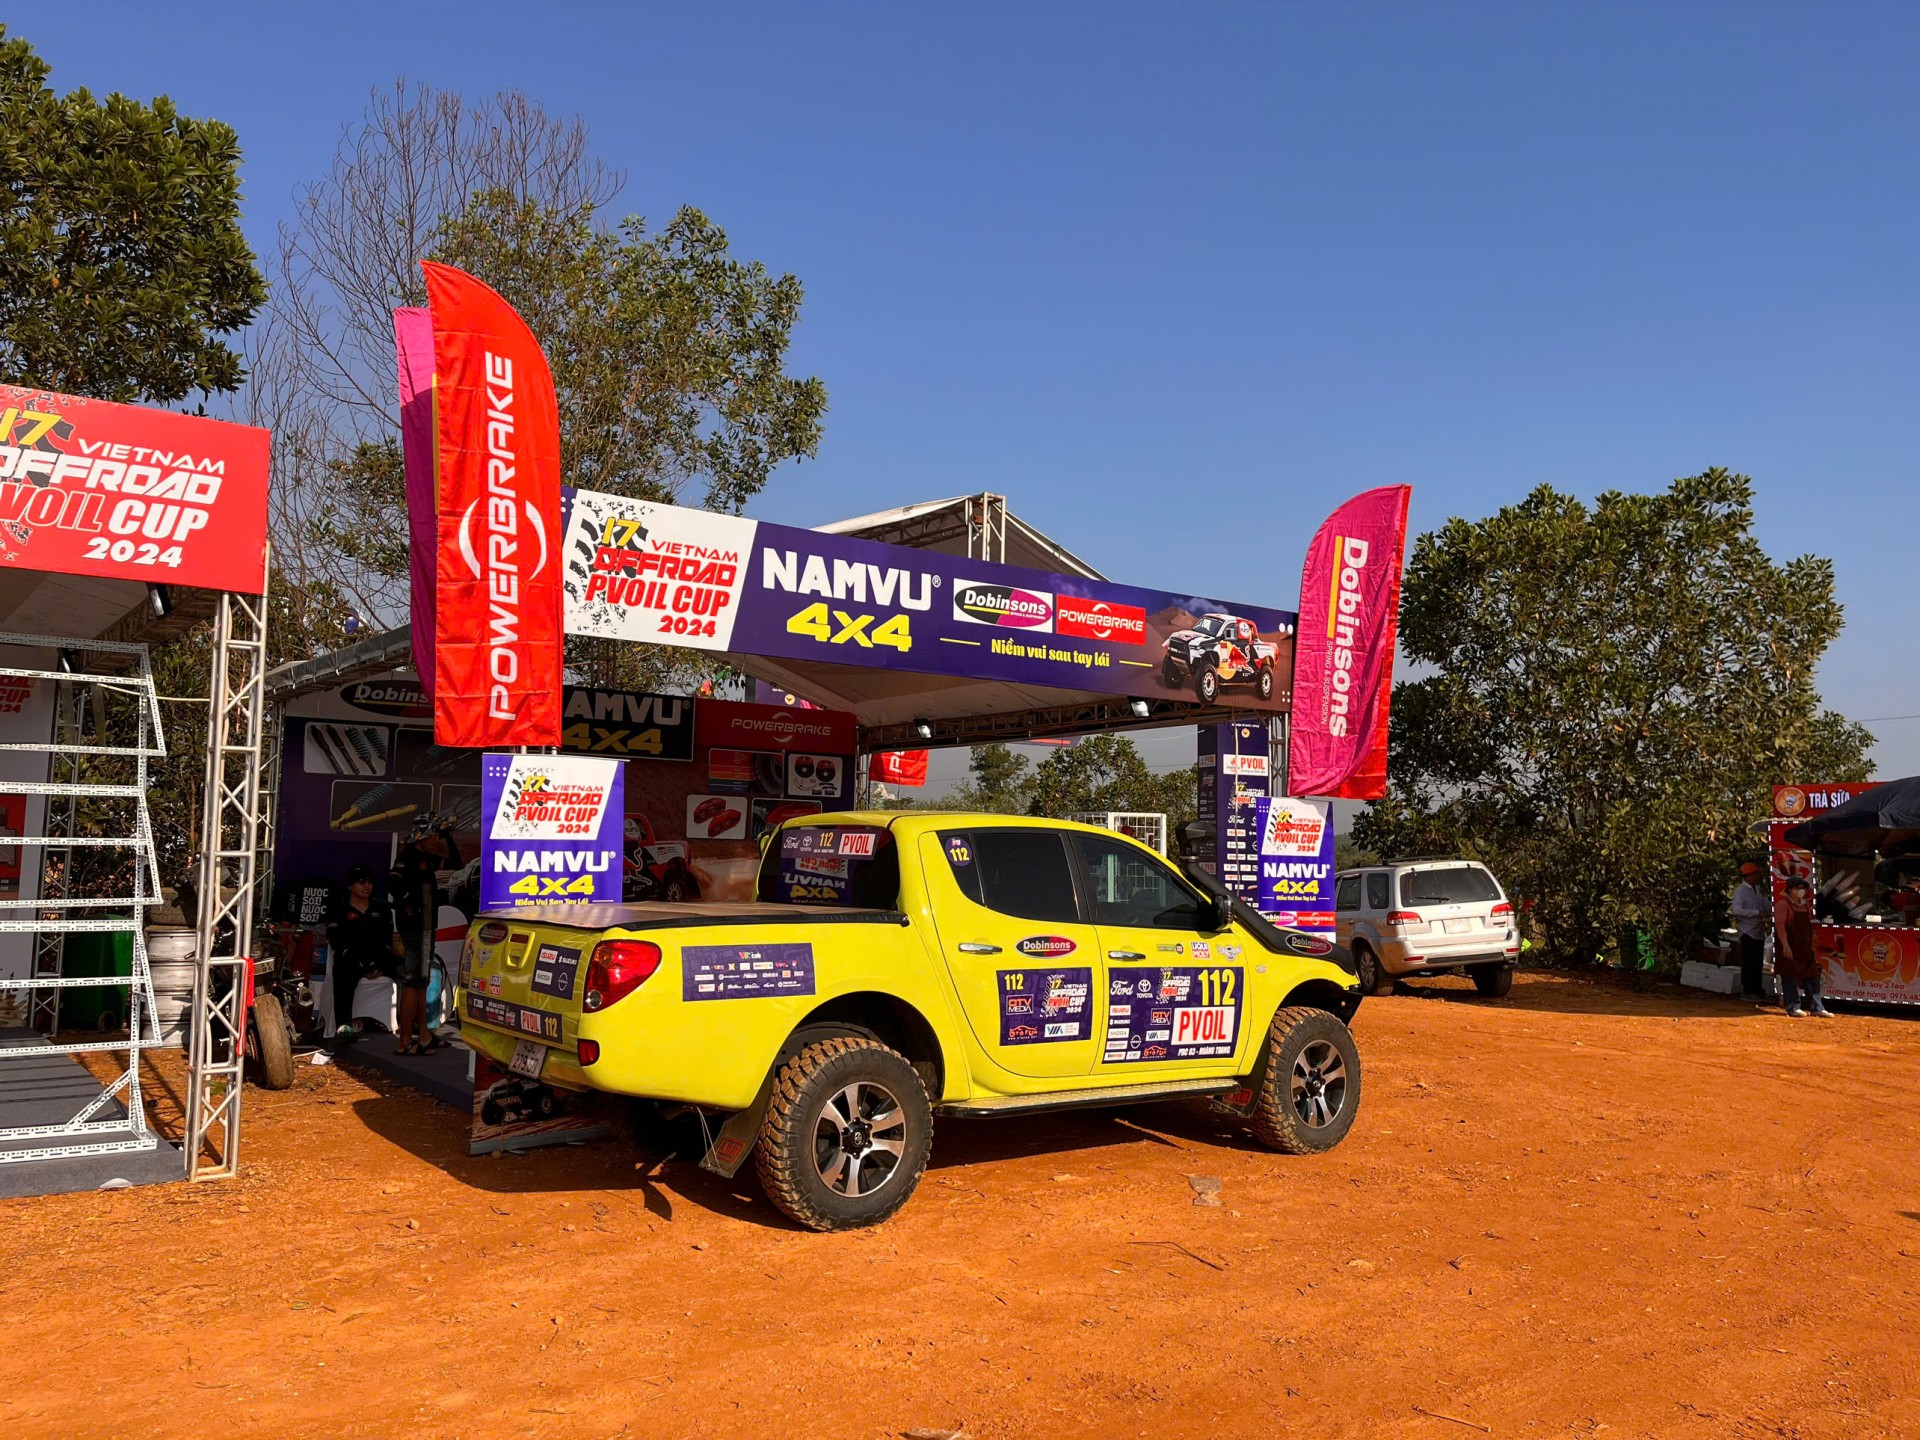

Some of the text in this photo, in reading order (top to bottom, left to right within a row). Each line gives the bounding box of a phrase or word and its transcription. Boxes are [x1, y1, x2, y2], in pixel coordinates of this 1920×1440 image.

[77, 438, 225, 475] VIETNAM
[108, 499, 209, 542] CUP
[485, 351, 518, 720] POWERBRAKE
[601, 517, 642, 547] 17
[82, 537, 183, 568] 2024
[651, 539, 739, 563] VIETNAM
[593, 546, 737, 587] OFFROAD
[584, 573, 730, 617] PVOIL CUP
[964, 589, 1047, 615] Dobinsons
[657, 615, 716, 638] 2024
[1059, 609, 1144, 632] POWERBRAKE
[1329, 537, 1369, 738] Dobinsons
[991, 637, 1110, 668] Niềm vui sau tay lái
[1324, 640, 1333, 669] SPRING
[1321, 677, 1330, 725] SUSPENSION
[731, 718, 832, 736] POWERBRAKE
[1241, 757, 1265, 770] PVOIL
[523, 775, 547, 791] 17
[552, 784, 604, 792] VIETNAM
[519, 791, 602, 806] OFFROAD
[515, 806, 599, 822] PVOIL CUP
[556, 823, 590, 834] 2024
[1274, 832, 1320, 844] PVOIL CUP
[784, 836, 800, 849] Ford
[820, 832, 870, 853] 112 PVOIL
[950, 847, 970, 861] 112
[1023, 940, 1070, 949] Dobinsons
[1291, 937, 1327, 949] Dobinsons
[1004, 973, 1024, 990] 112
[1051, 979, 1063, 989] 17
[1110, 980, 1133, 995] Ford
[1198, 969, 1235, 1006] 112
[1070, 997, 1086, 1006] CUP
[544, 1016, 558, 1038] 112
[1178, 1010, 1226, 1042] PVOIL
